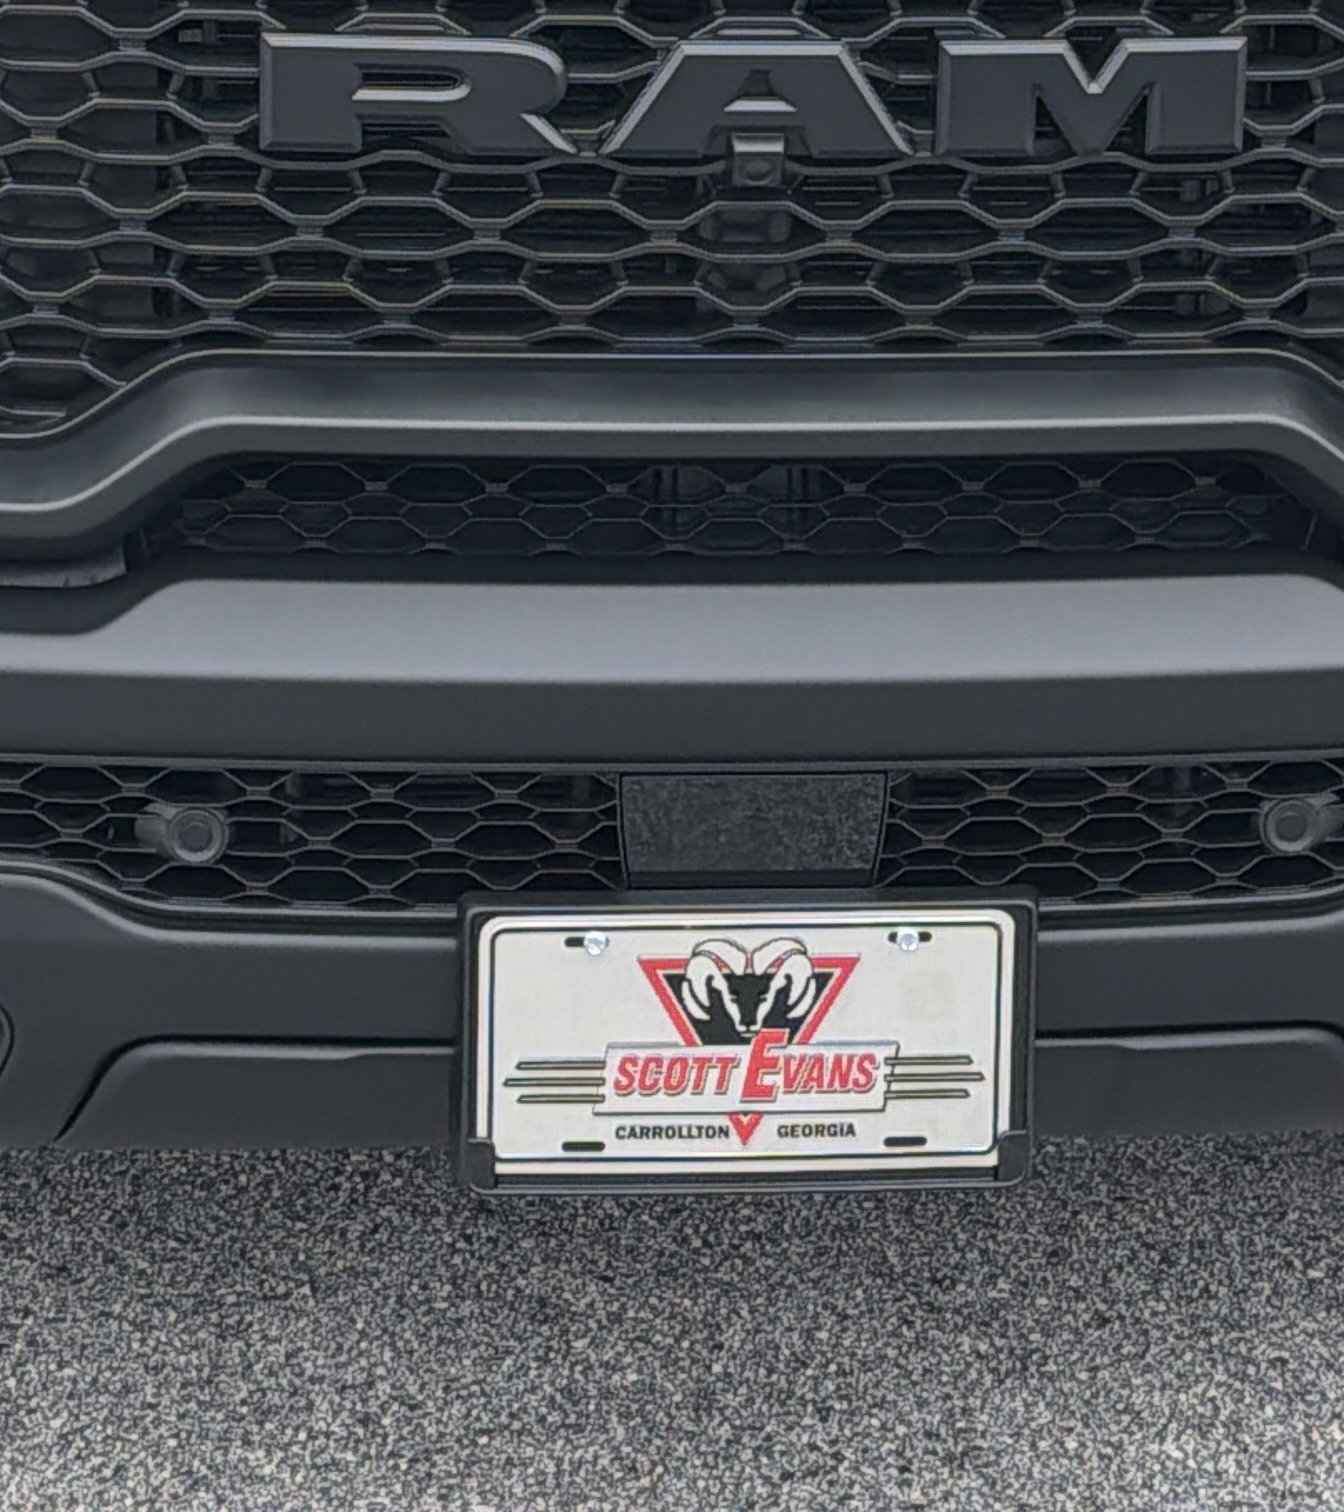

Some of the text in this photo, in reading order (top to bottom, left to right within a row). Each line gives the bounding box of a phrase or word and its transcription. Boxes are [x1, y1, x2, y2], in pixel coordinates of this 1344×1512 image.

[259, 33, 1247, 156] RAM
[613, 1028, 880, 1103] SCOTT EVANS
[614, 1122, 857, 1140] CARROLLTON GEORGIA
